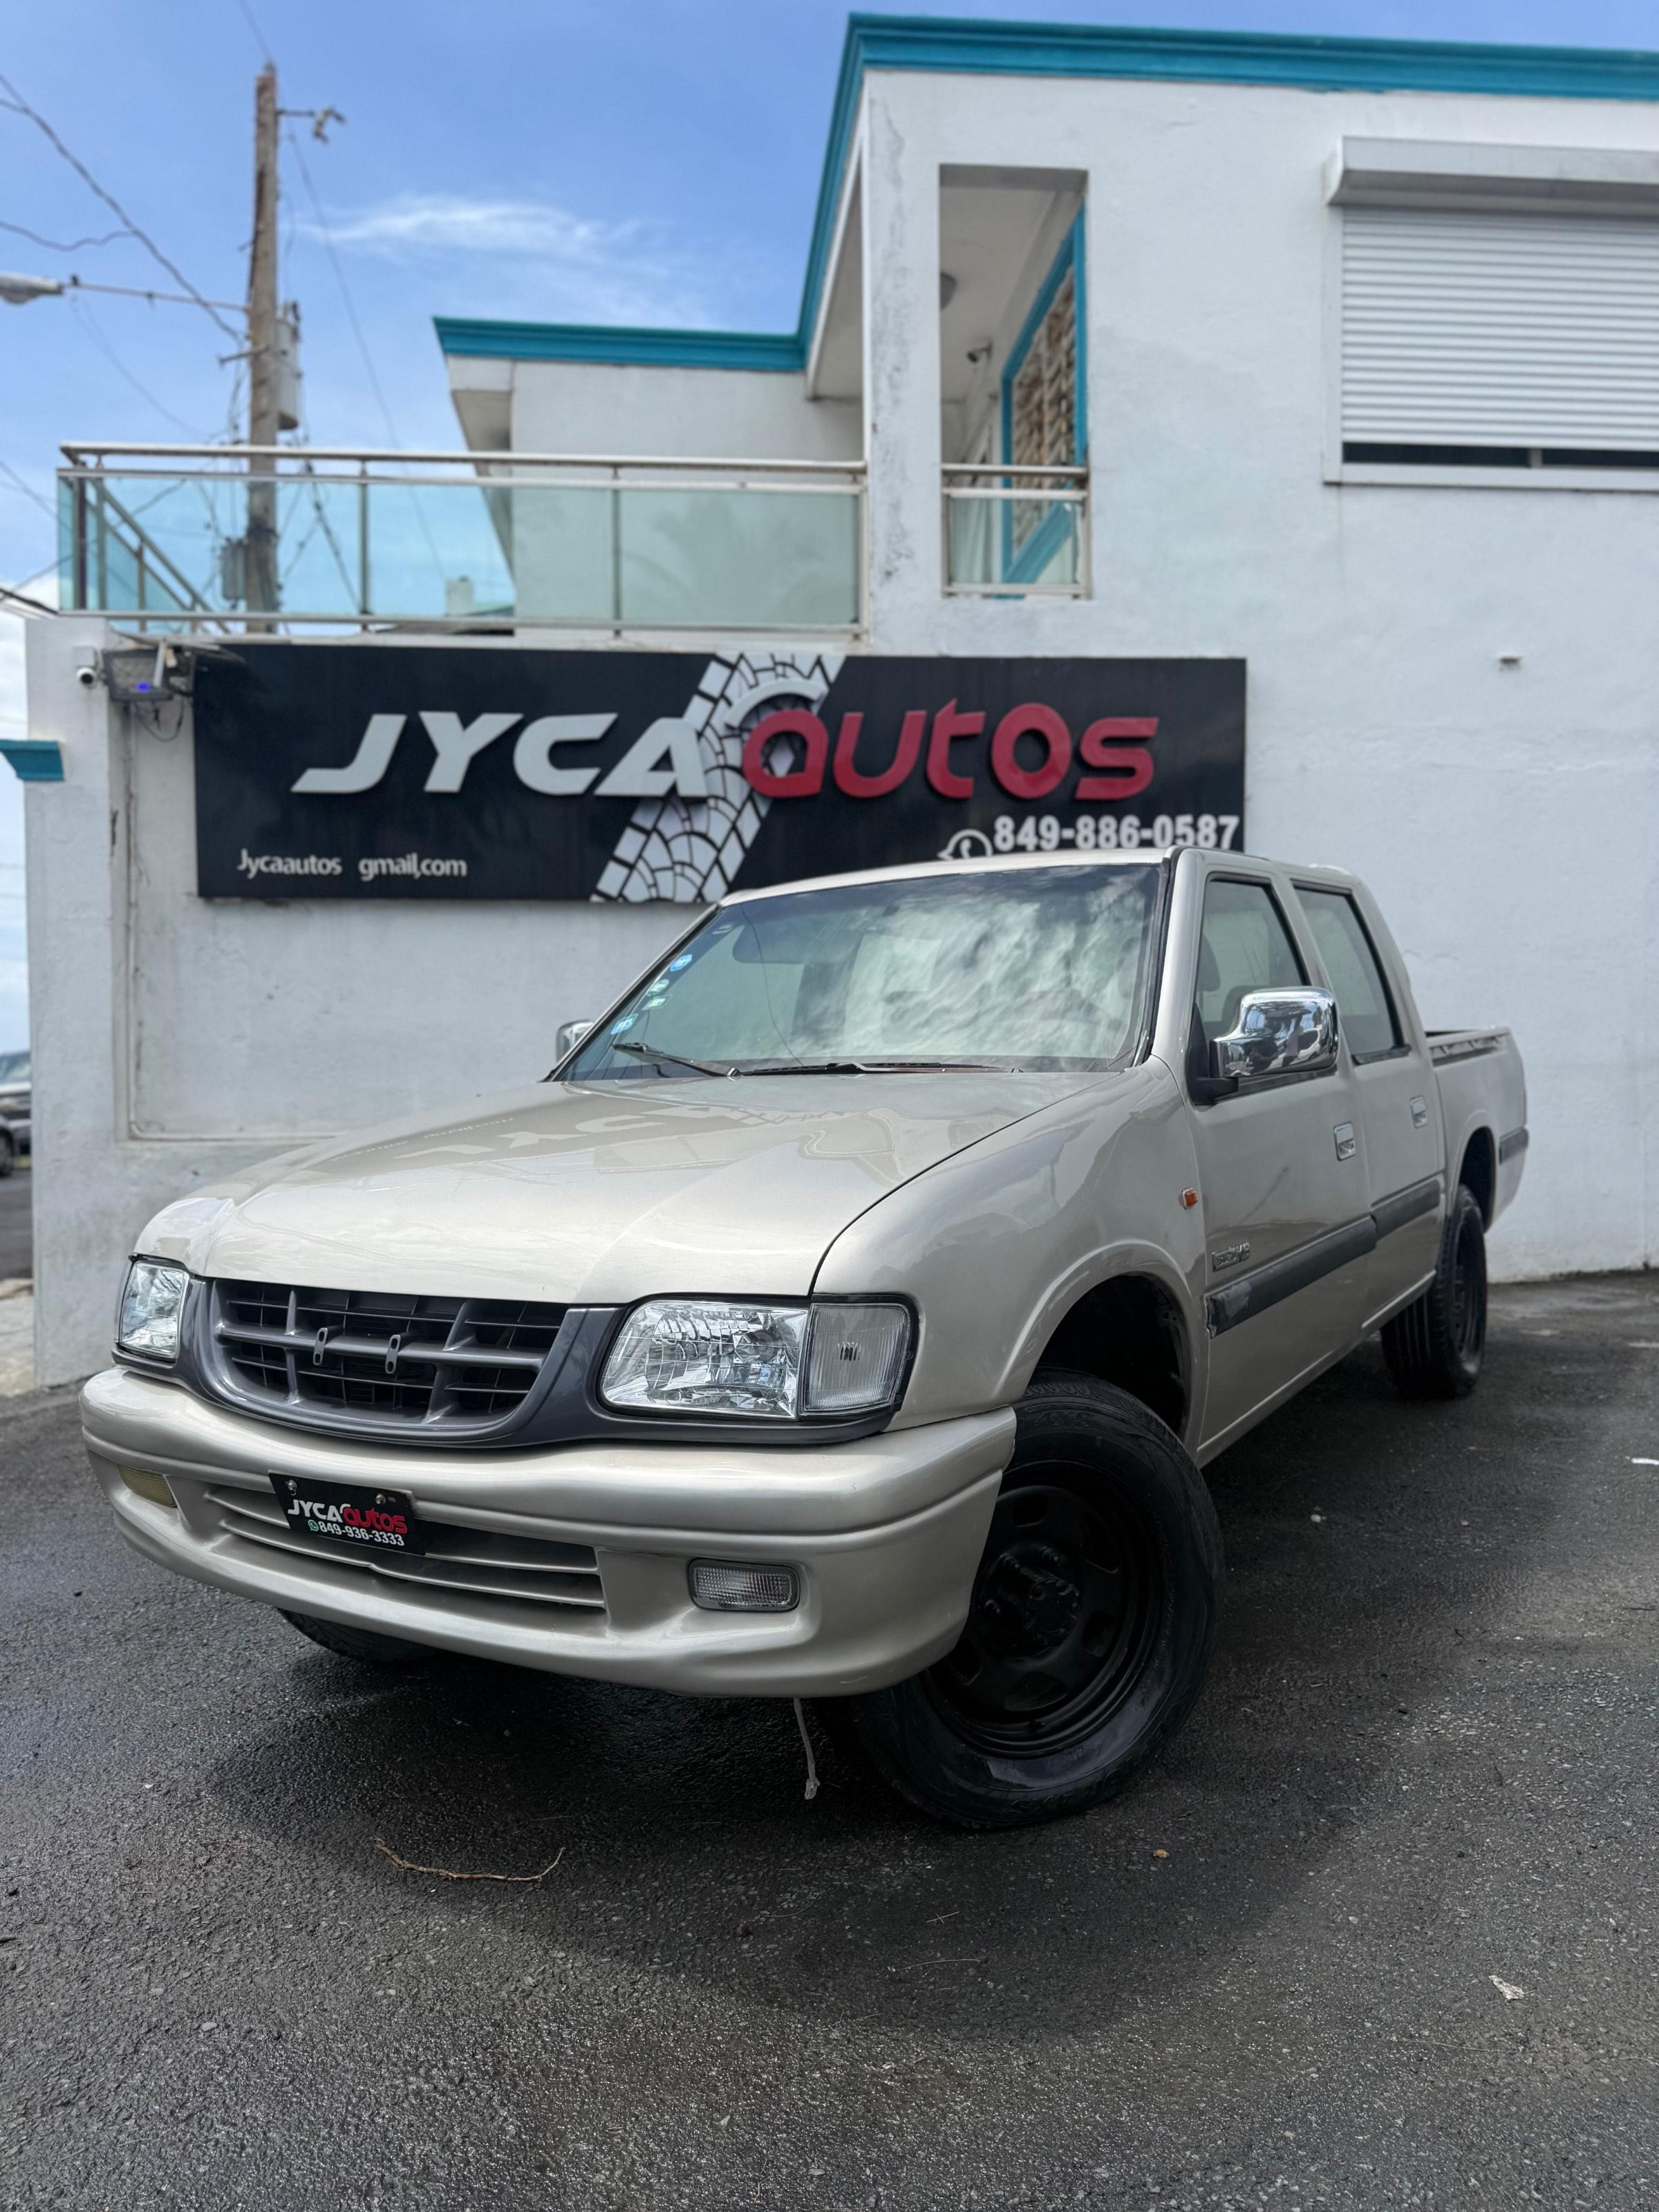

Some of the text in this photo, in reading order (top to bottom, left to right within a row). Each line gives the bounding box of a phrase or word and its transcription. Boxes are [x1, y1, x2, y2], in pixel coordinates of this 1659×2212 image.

[290, 711, 709, 798] JYCA
[993, 814, 1240, 852] 849-886-0587
[237, 849, 343, 879] Jycaautos
[318, 1521, 405, 1546] 849-936-3333
